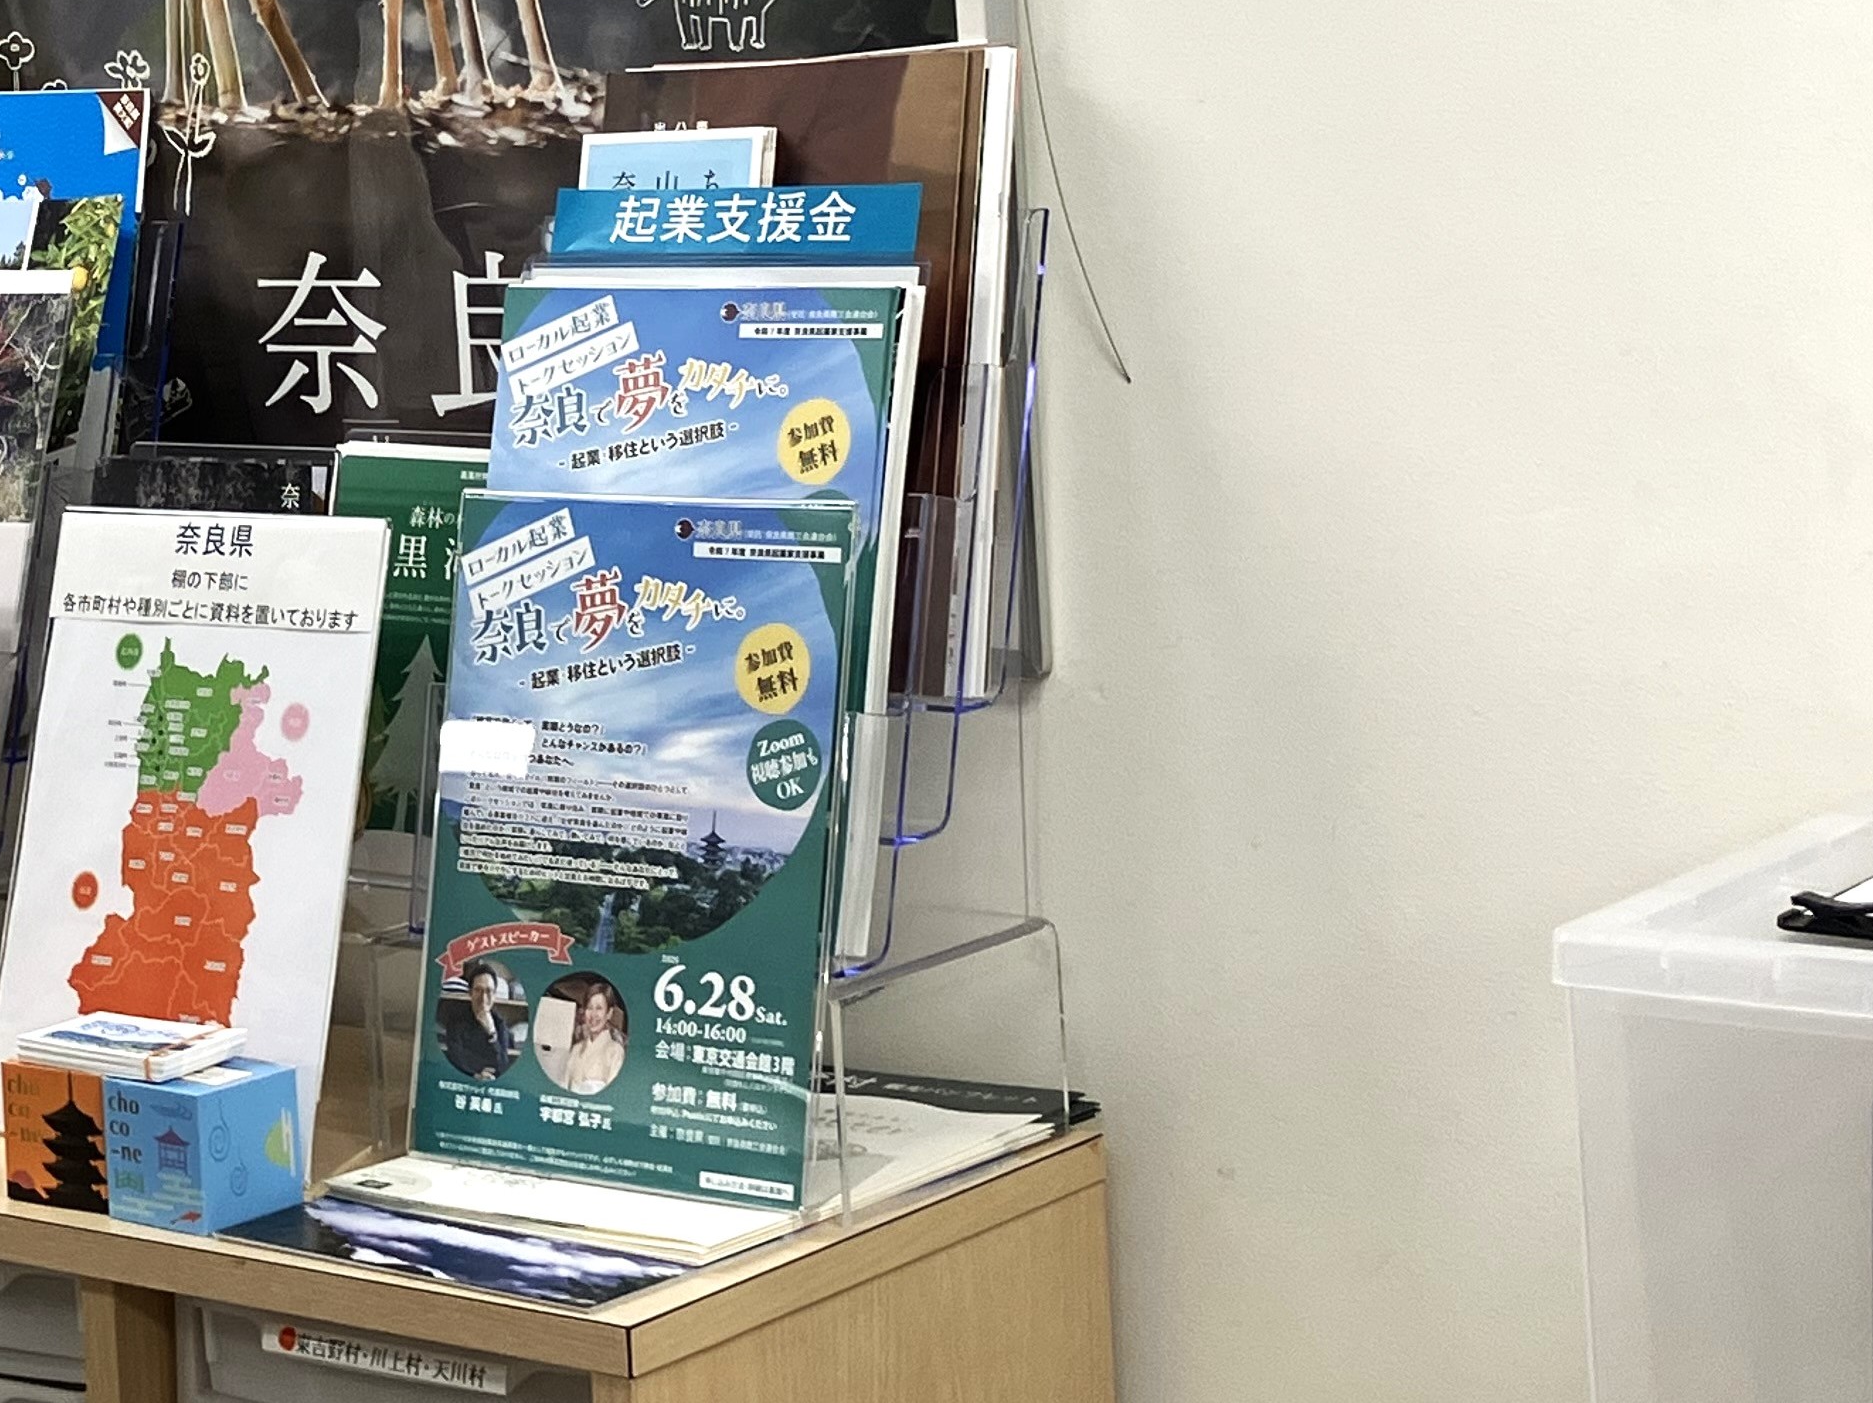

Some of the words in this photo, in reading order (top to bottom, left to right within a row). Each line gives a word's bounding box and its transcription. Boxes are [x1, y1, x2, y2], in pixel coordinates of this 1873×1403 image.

[610, 190, 857, 245] 起業支援金
[507, 300, 614, 364] ローカル起業
[517, 330, 633, 393] トークセッション
[510, 348, 790, 448] 奈良で夢をカタチに。
[787, 414, 835, 448] 参加費
[798, 439, 839, 474] 無料
[175, 522, 254, 558] 奈良県
[468, 513, 570, 577] ローカル起業
[171, 569, 249, 592] 棚の下部に
[475, 547, 591, 613] トークセッション
[63, 592, 359, 631] 各市町村や種別ごとに資料を置いております
[472, 566, 747, 665] 奈良で夢をカタチに。
[744, 639, 794, 675] 参加費
[755, 667, 800, 702] 無料
[757, 730, 806, 757] Zoom
[749, 752, 820, 785] 視聴参加も
[775, 778, 805, 802] OK
[467, 929, 551, 952] ゲストスピーカー
[653, 964, 756, 1021] 6.28
[754, 1006, 788, 1027] Sat.
[655, 1017, 747, 1044] 14:00-16:00
[107, 1092, 141, 1116] cho
[108, 1118, 132, 1138] co
[110, 1143, 143, 1165] -ne
[297, 1332, 487, 1389] 東吉野村・川上村・天川村
